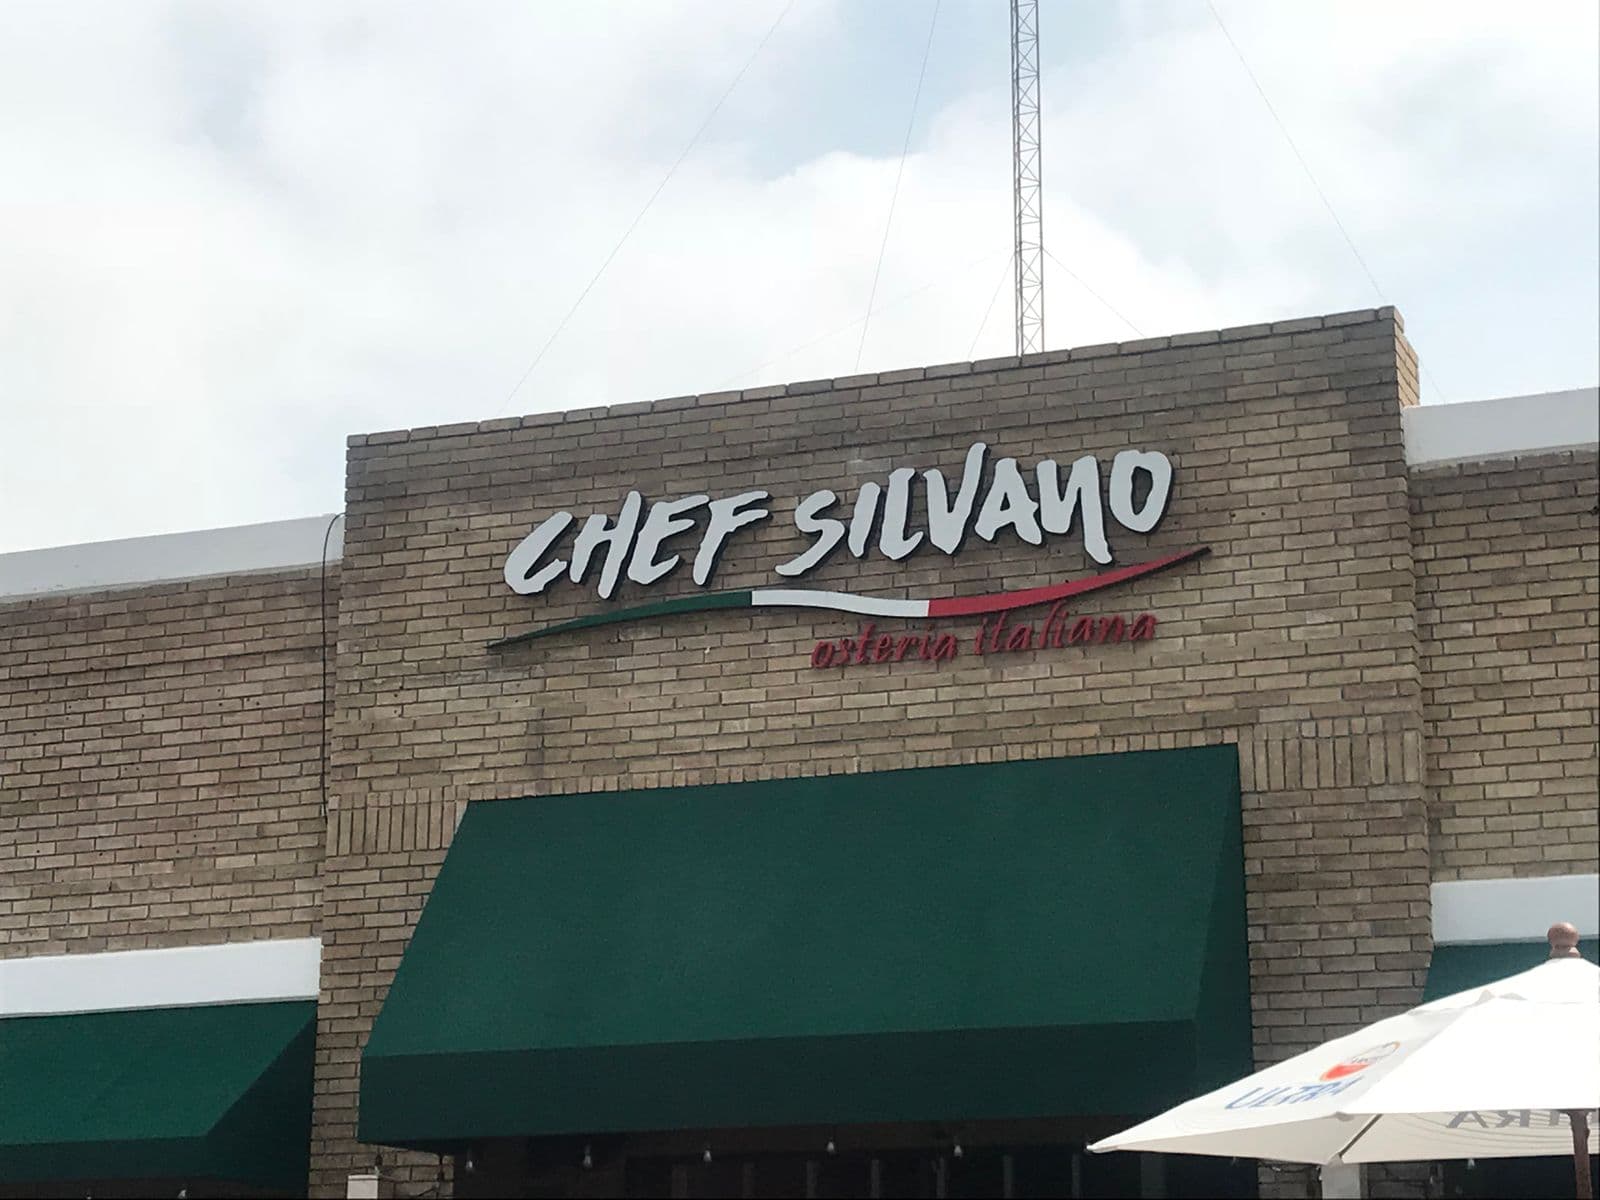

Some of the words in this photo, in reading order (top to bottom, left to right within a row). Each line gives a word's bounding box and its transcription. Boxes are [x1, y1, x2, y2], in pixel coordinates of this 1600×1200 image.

[503, 490, 771, 600] CHEF
[775, 442, 1173, 577] SILVANO
[811, 622, 958, 669] osteria
[973, 600, 1157, 656] italiana
